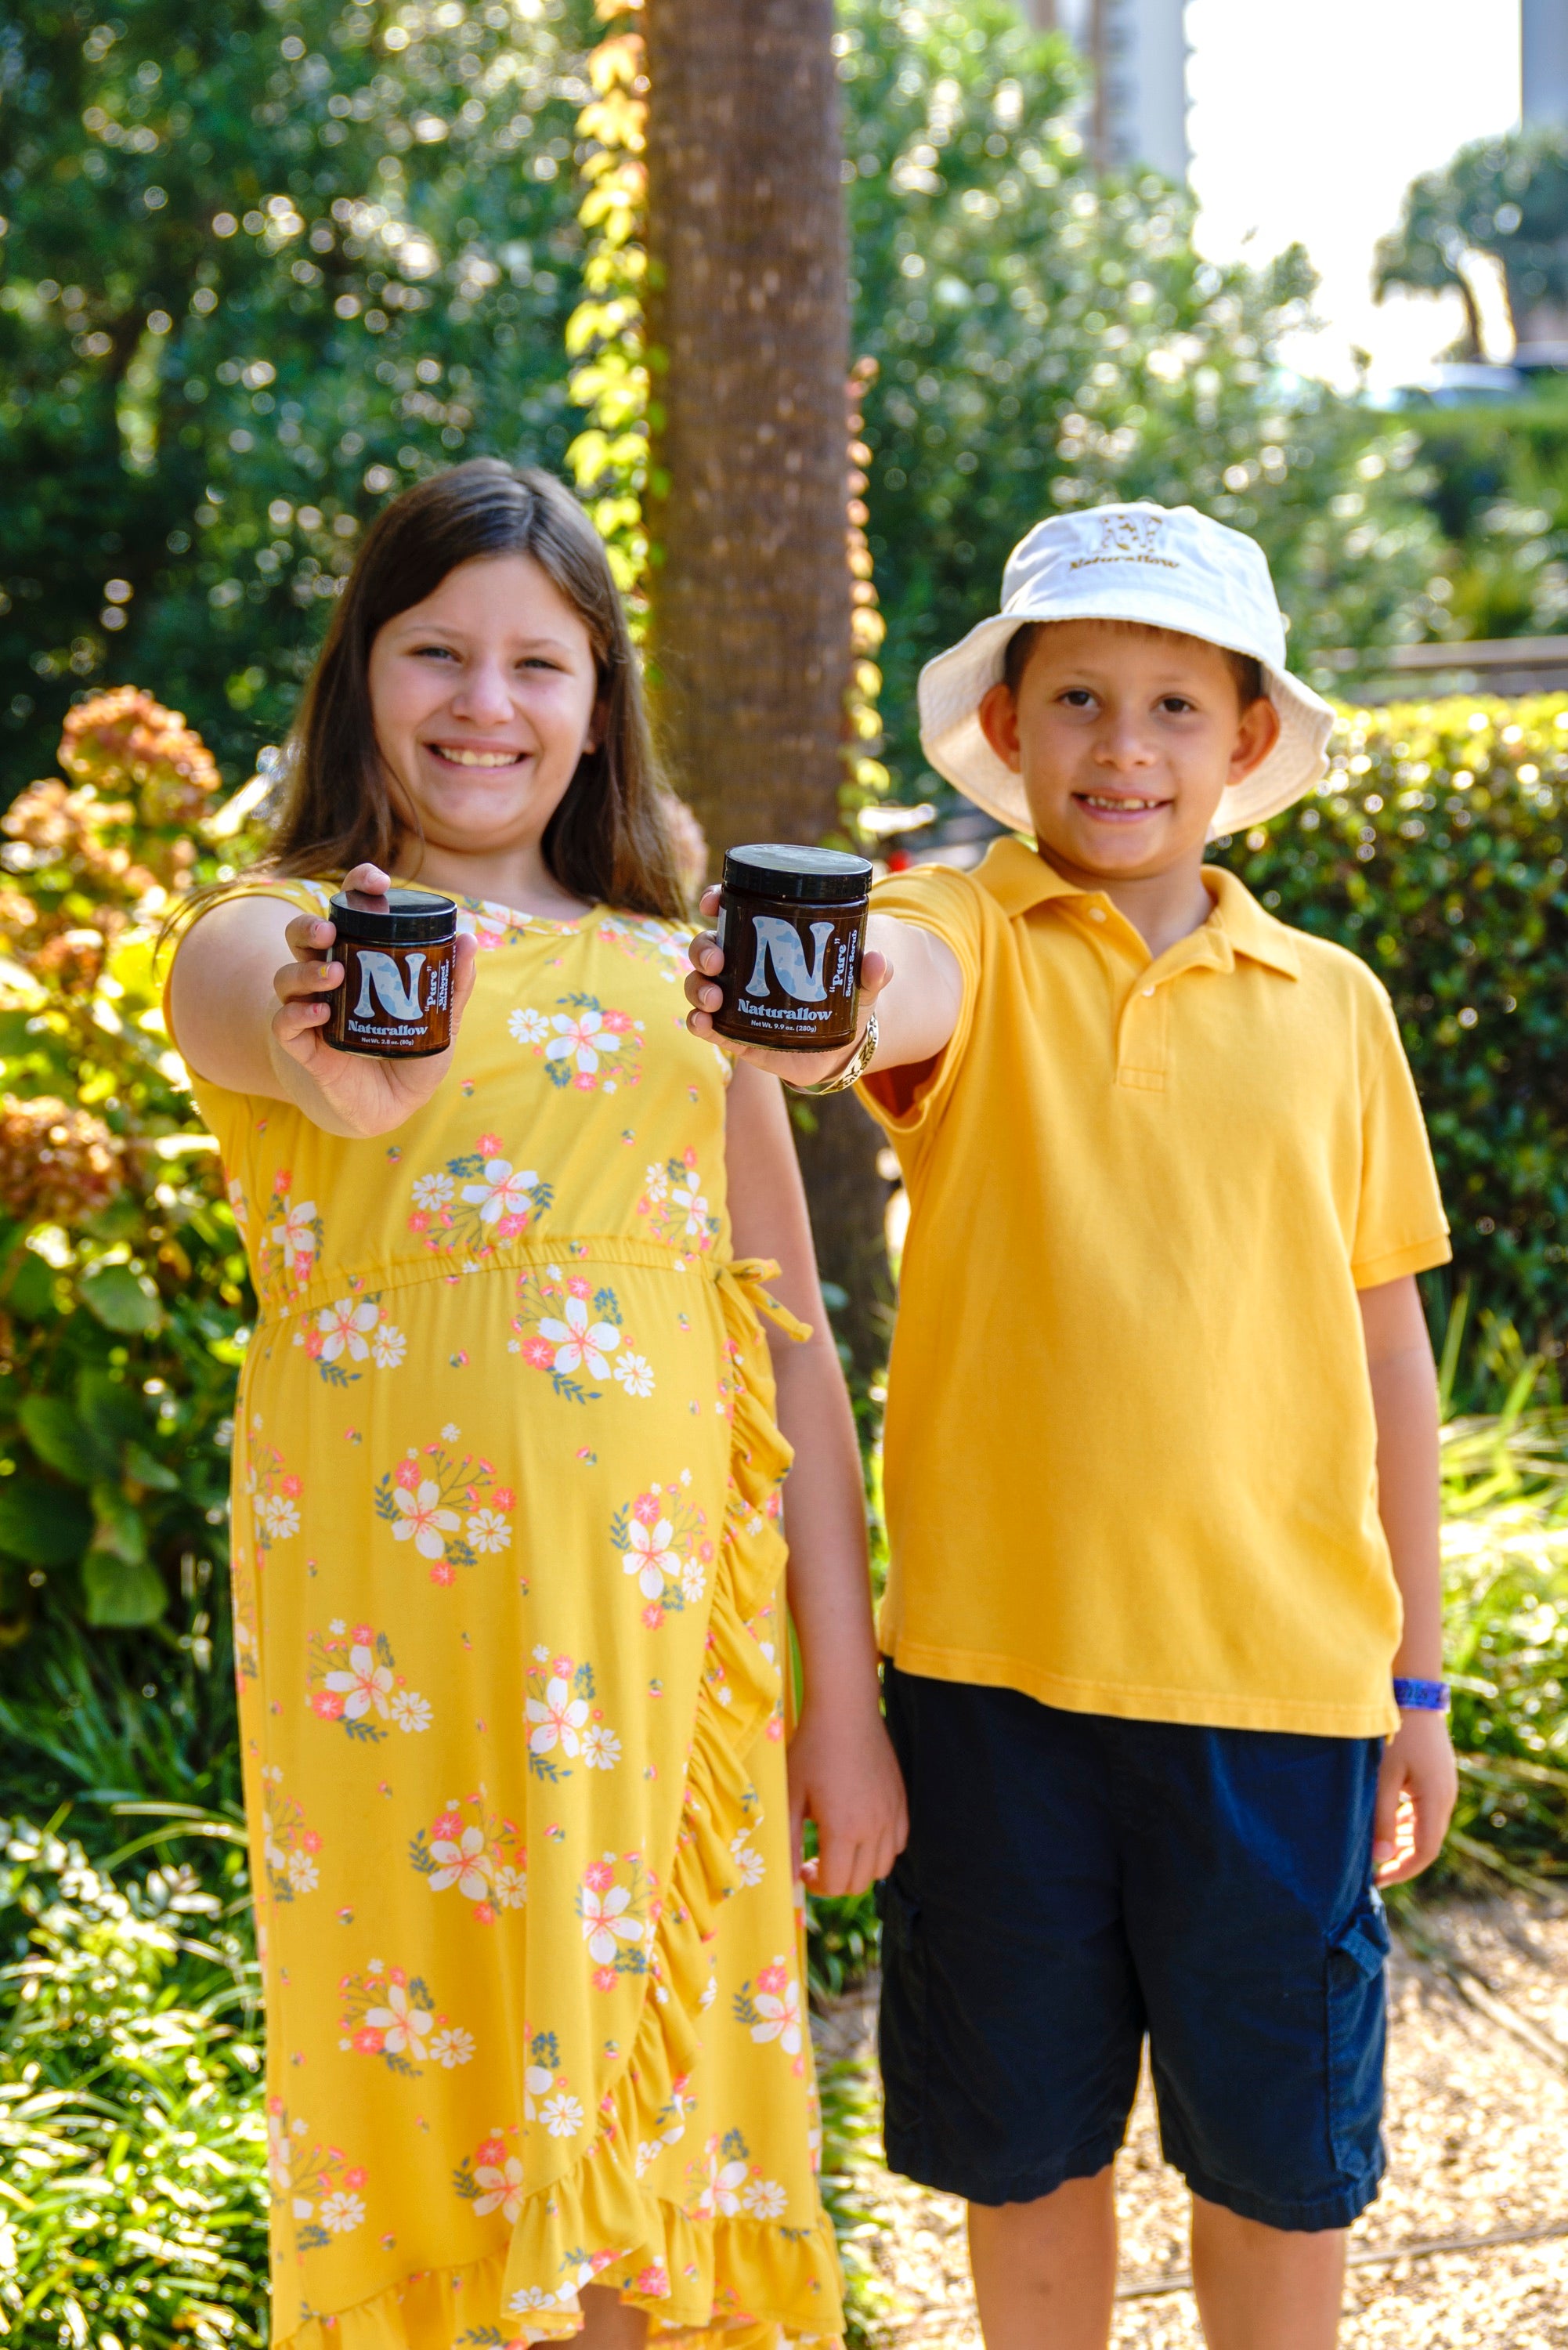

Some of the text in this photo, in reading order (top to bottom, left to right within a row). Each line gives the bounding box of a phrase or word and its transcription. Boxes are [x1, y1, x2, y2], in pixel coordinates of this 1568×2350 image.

[353, 950, 427, 1021] N
[745, 916, 835, 1002] N
[845, 929, 858, 997] Sugar Scrub
[348, 1019, 428, 1036] Naturallow
[738, 998, 833, 1021] Naturallow
